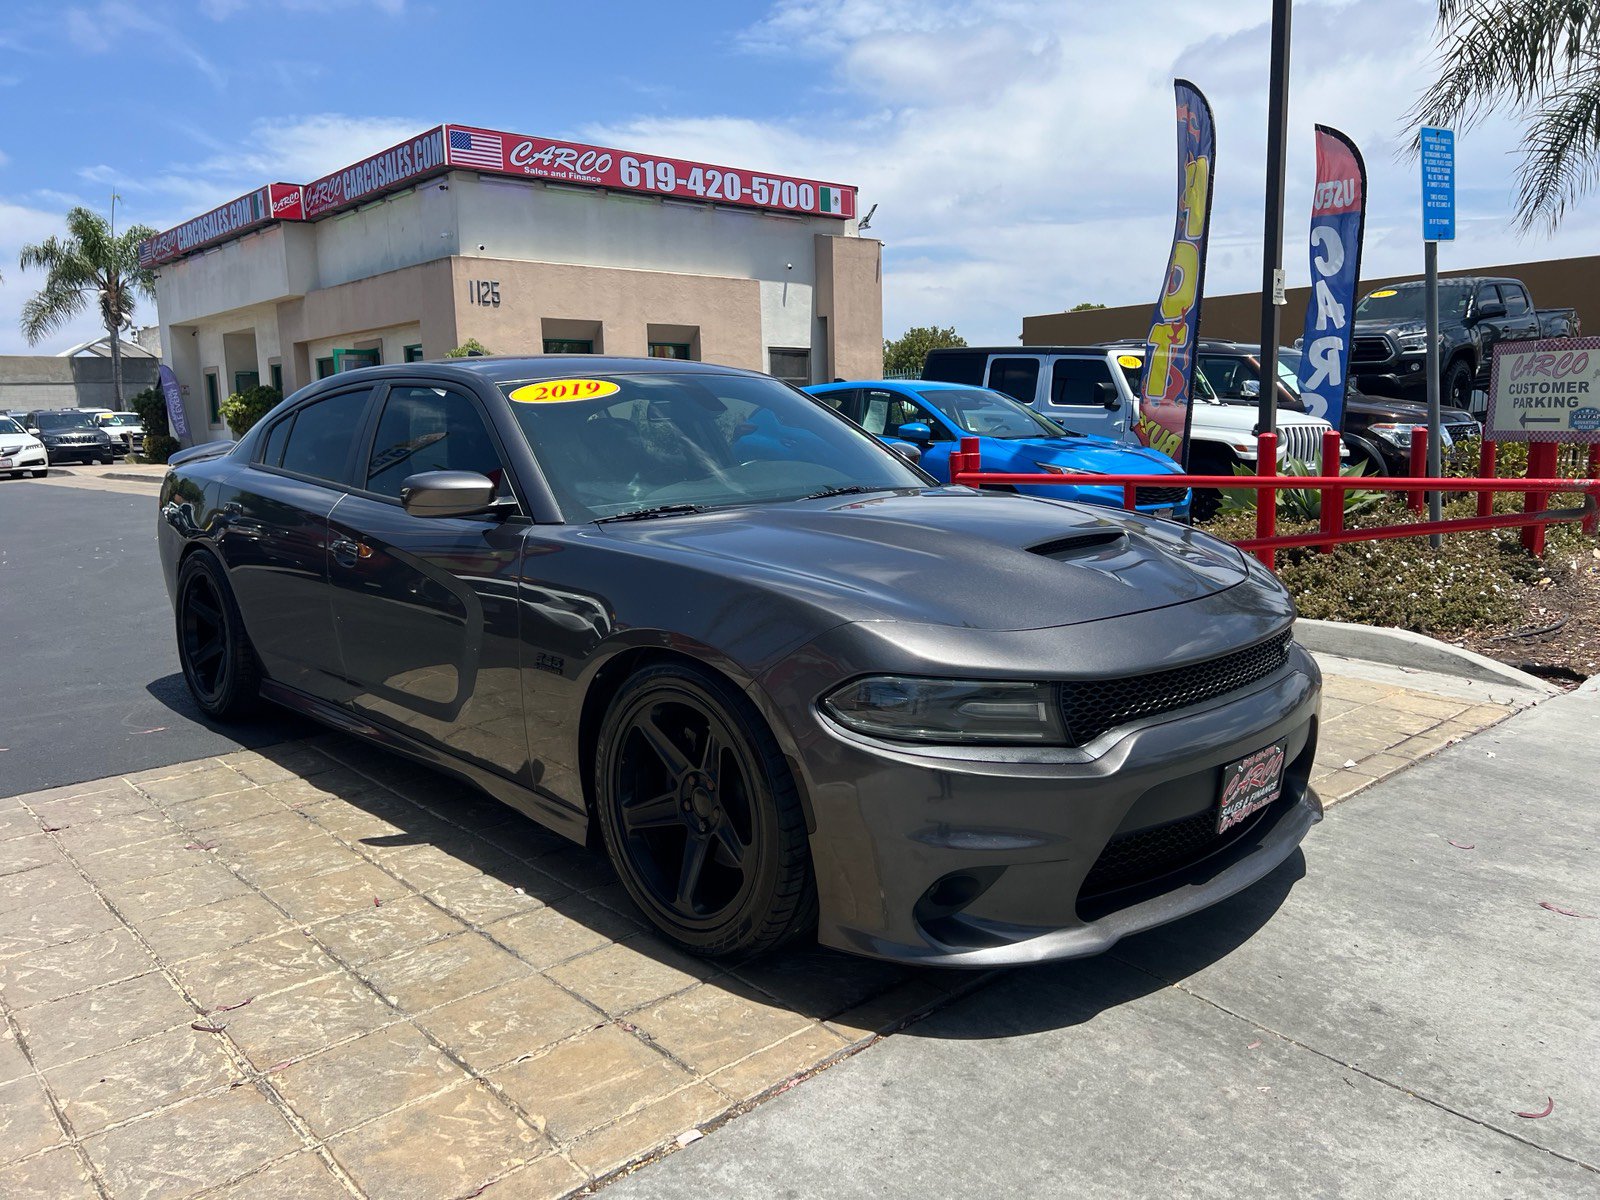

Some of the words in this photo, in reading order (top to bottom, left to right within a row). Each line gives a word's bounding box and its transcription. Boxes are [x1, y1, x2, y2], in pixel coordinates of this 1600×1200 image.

[343, 131, 444, 200] CARCOSALES.COM
[509, 141, 613, 175] CARCO
[523, 166, 549, 176] Sales
[568, 172, 602, 183] Finance
[619, 156, 815, 212] 619-420-5700
[272, 191, 300, 212] CARCO
[305, 175, 342, 212] CARCO
[177, 197, 252, 250] CARCOSALES.COM
[151, 230, 177, 257] CARCO
[469, 279, 501, 308] 1125
[1509, 352, 1590, 381] CARCO
[534, 382, 601, 401] 2019
[1508, 381, 1590, 395] CUSTOMER
[1513, 396, 1579, 409] PARKING
[1220, 799, 1245, 818] SALES
[1249, 780, 1278, 802] FINANCE
